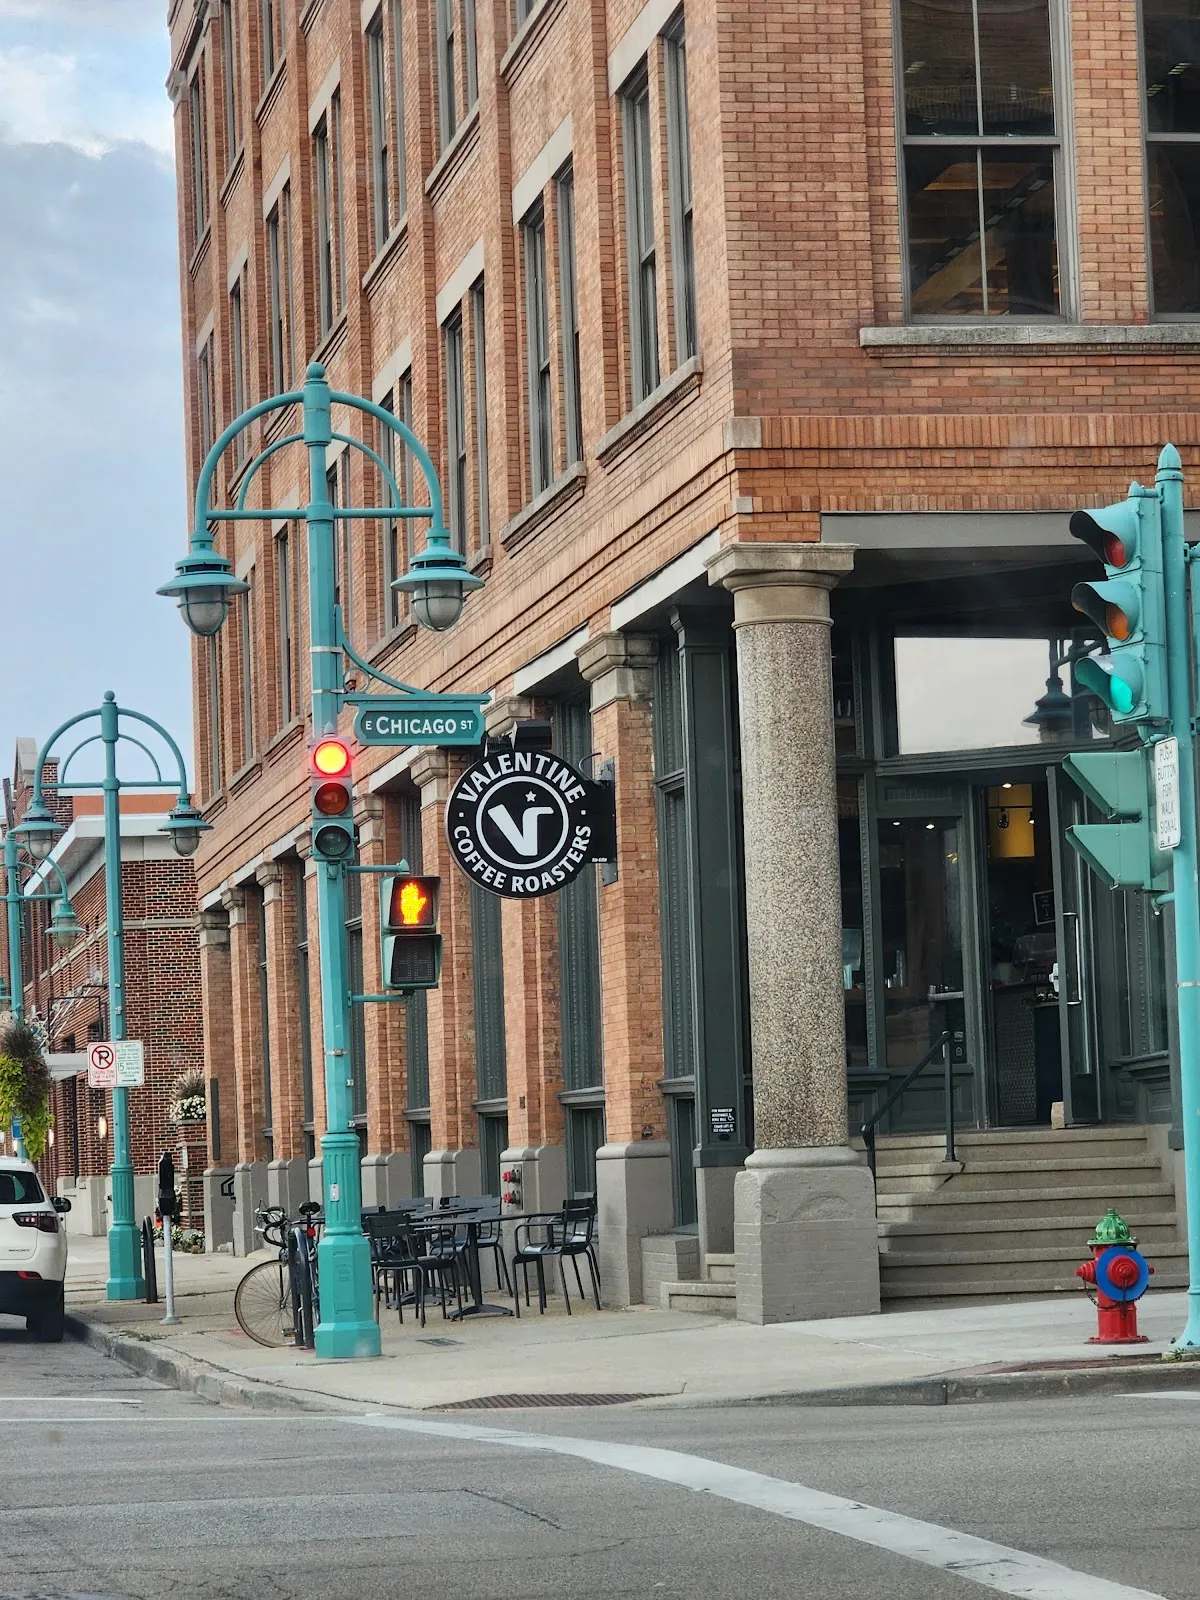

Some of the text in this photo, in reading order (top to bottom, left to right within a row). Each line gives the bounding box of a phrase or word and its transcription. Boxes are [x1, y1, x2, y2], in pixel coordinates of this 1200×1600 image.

[365, 716, 473, 735] E CHICAGO ST
[457, 751, 586, 804] VALENTINE
[1157, 764, 1176, 781] BUTTON
[454, 825, 592, 893] COFFEE ROASTERS
